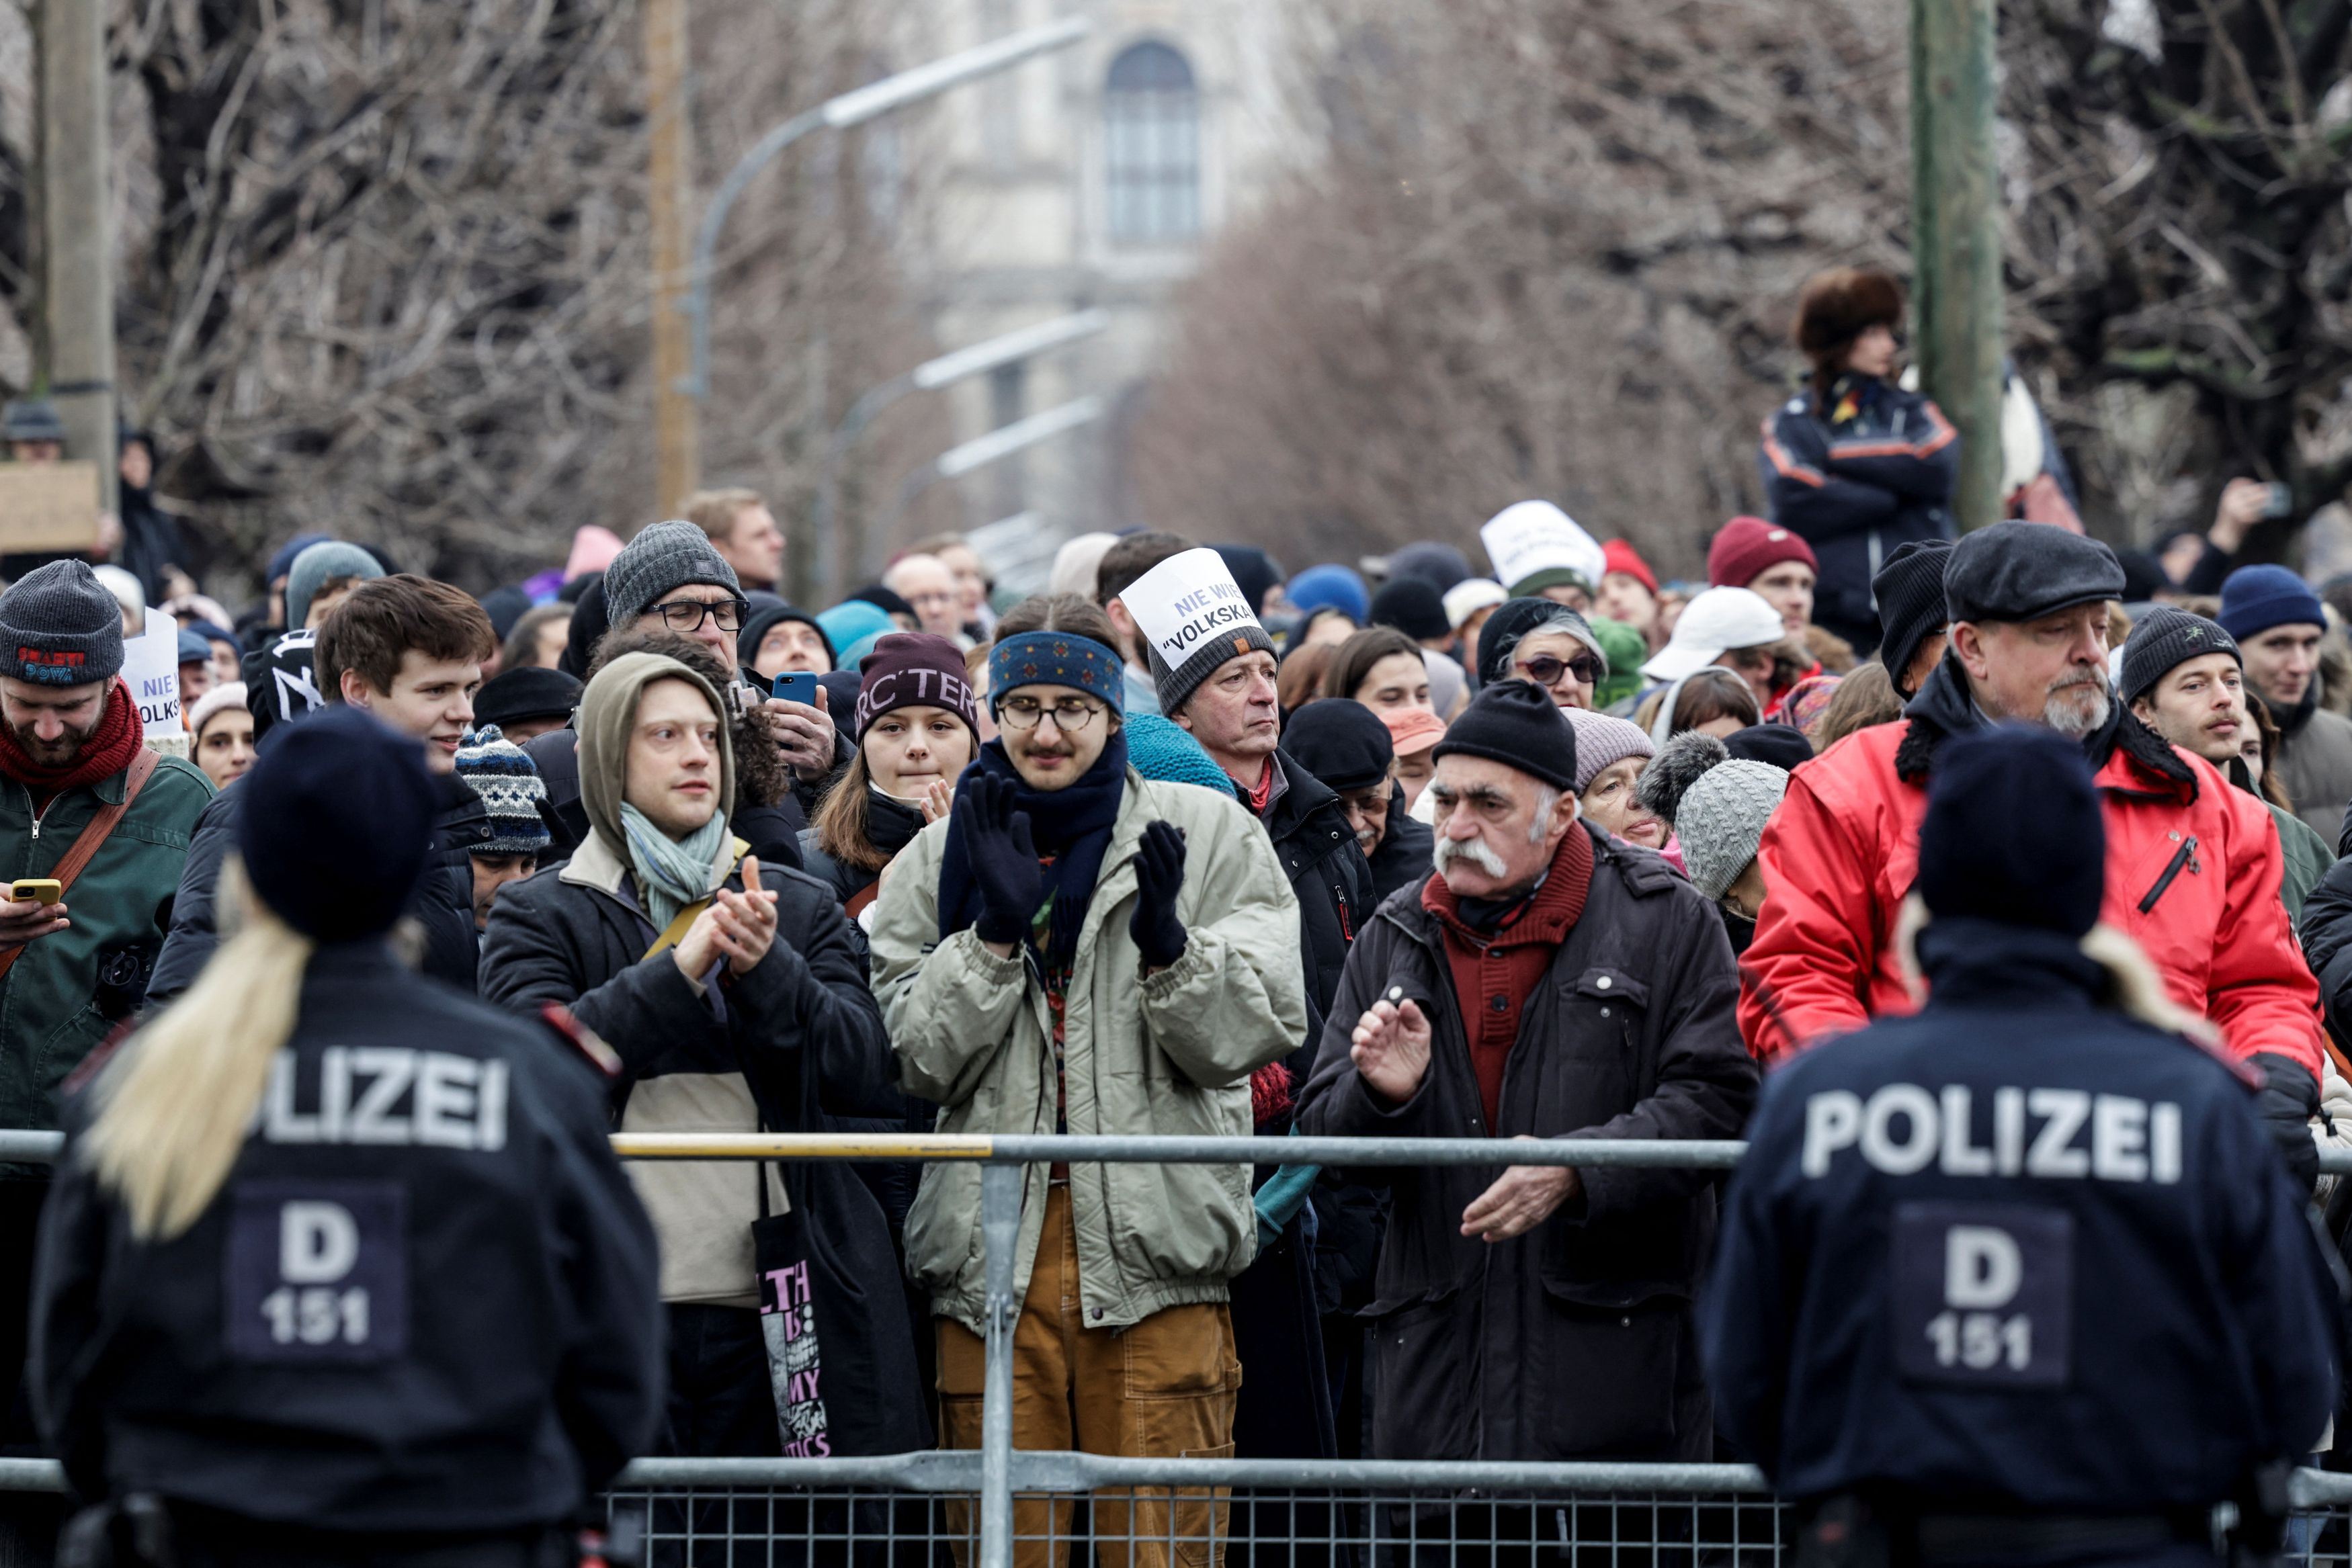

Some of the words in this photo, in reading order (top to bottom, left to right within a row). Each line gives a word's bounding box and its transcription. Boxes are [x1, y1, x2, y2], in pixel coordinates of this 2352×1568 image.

[1163, 604, 1256, 651] “VOLKSKA
[1175, 589, 1210, 617] NIE
[1208, 583, 1248, 601] WIE
[139, 699, 179, 724] OLKS
[143, 674, 173, 697] NIE
[855, 668, 979, 734] RC'TER
[263, 1045, 509, 1151] LIZEI
[1802, 1083, 2182, 1184] POLIZEI
[279, 1200, 360, 1284] D
[1945, 1224, 2023, 1309] D
[261, 1287, 369, 1344] 151
[1925, 1311, 2031, 1371] 151
[788, 1368, 820, 1405] MY
